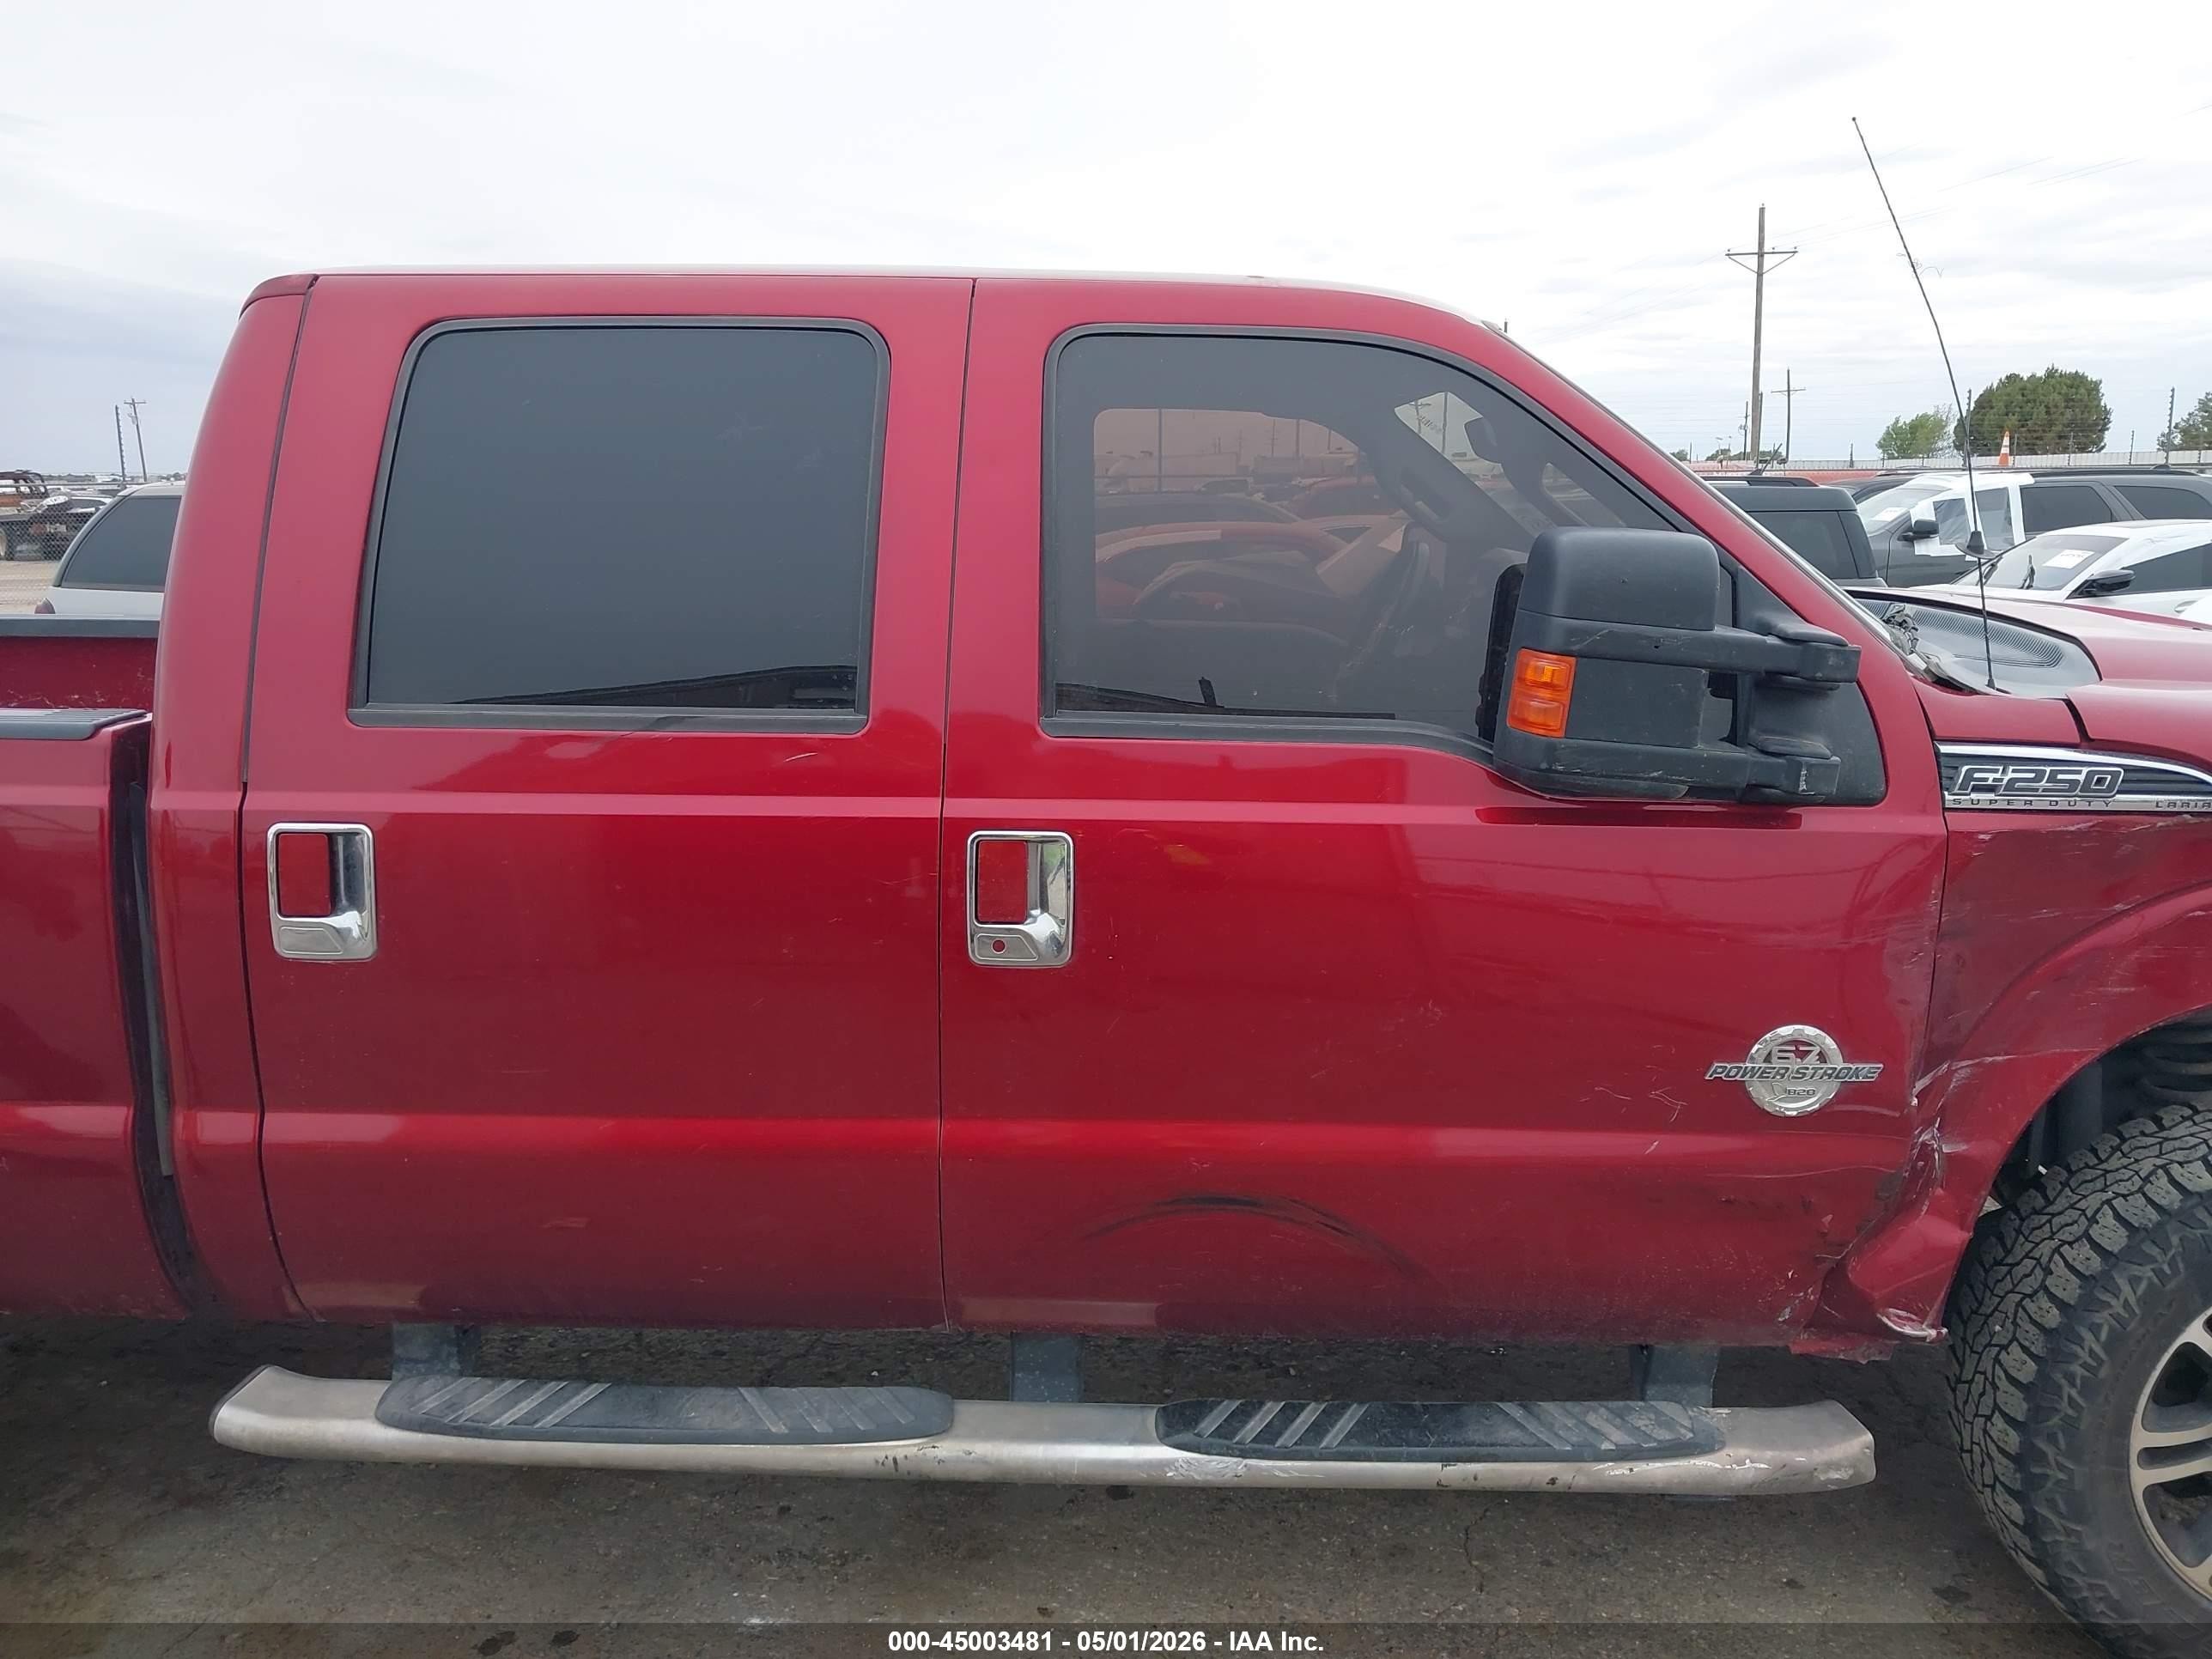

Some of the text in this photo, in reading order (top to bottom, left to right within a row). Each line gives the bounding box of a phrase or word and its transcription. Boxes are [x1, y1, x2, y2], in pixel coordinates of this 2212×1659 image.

[1948, 765, 2124, 799] F-250
[1952, 798, 2112, 808] SUPER DUTY
[1705, 1063, 1883, 1081] POWER STROKE
